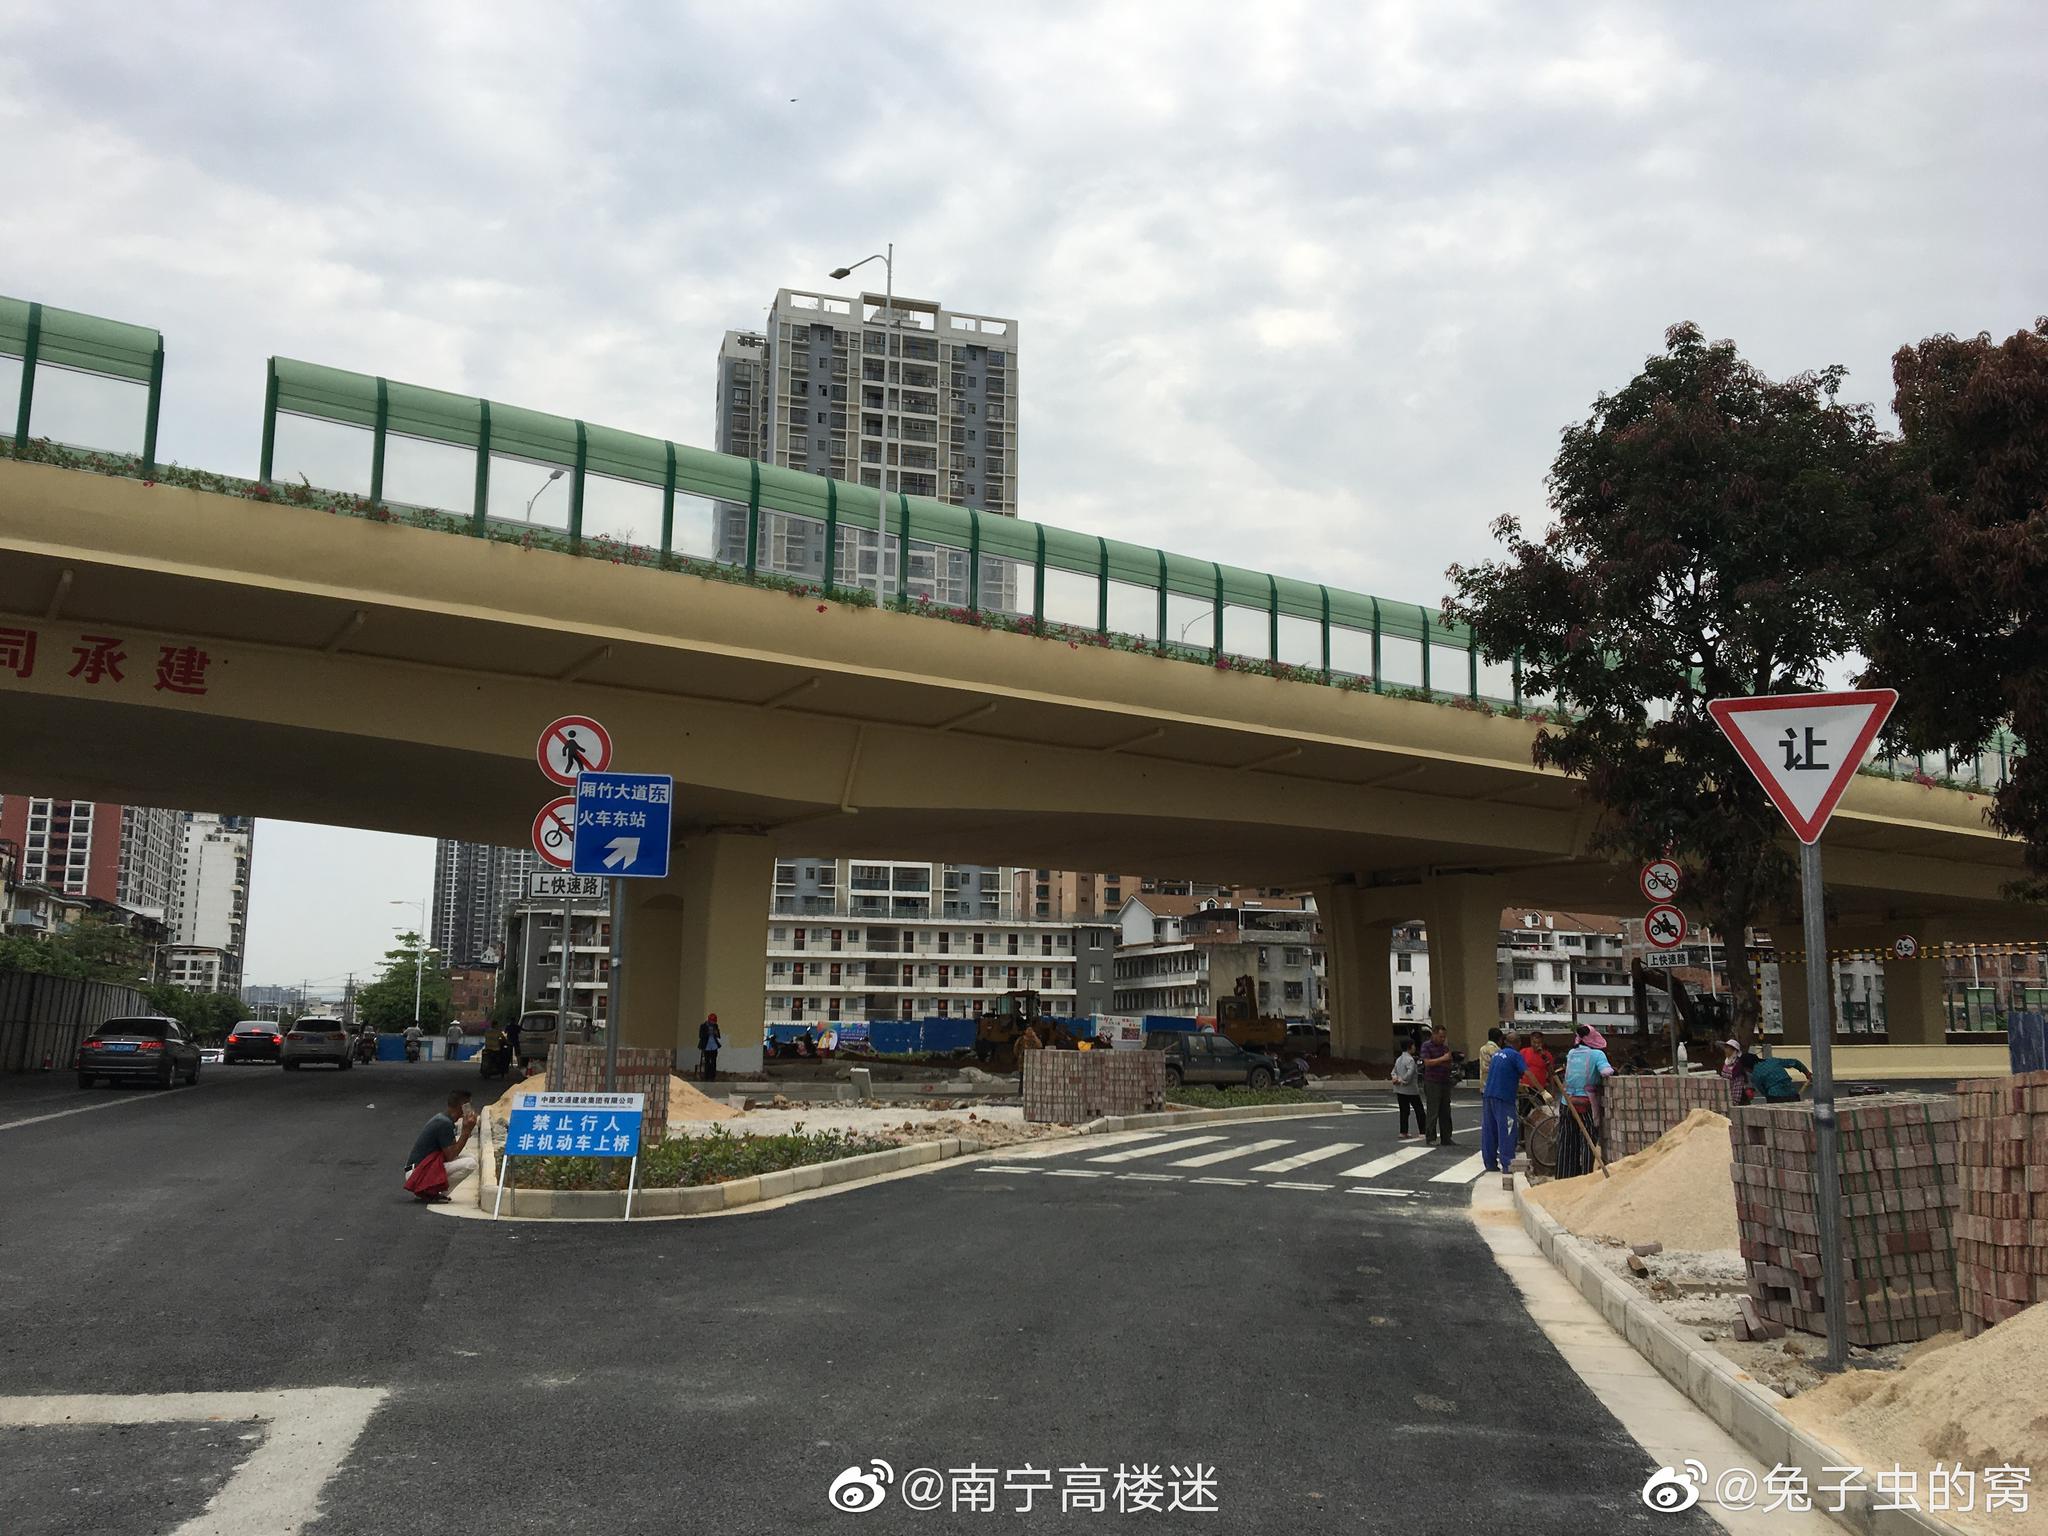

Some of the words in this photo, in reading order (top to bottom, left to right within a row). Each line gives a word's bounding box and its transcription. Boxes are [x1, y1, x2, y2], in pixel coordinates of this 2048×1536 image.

[0, 627, 211, 695] 司承建
[1778, 727, 1829, 771] 让
[579, 781, 668, 803] 厢竹大道东
[578, 810, 647, 828] 火车东站
[534, 876, 598, 895] 上快速路
[1651, 953, 1685, 966] 上快速路
[541, 1096, 634, 1105] 中建交通建设集团有限公司
[532, 1114, 620, 1132] 禁止行人
[517, 1133, 630, 1152] 非机动车上桥
